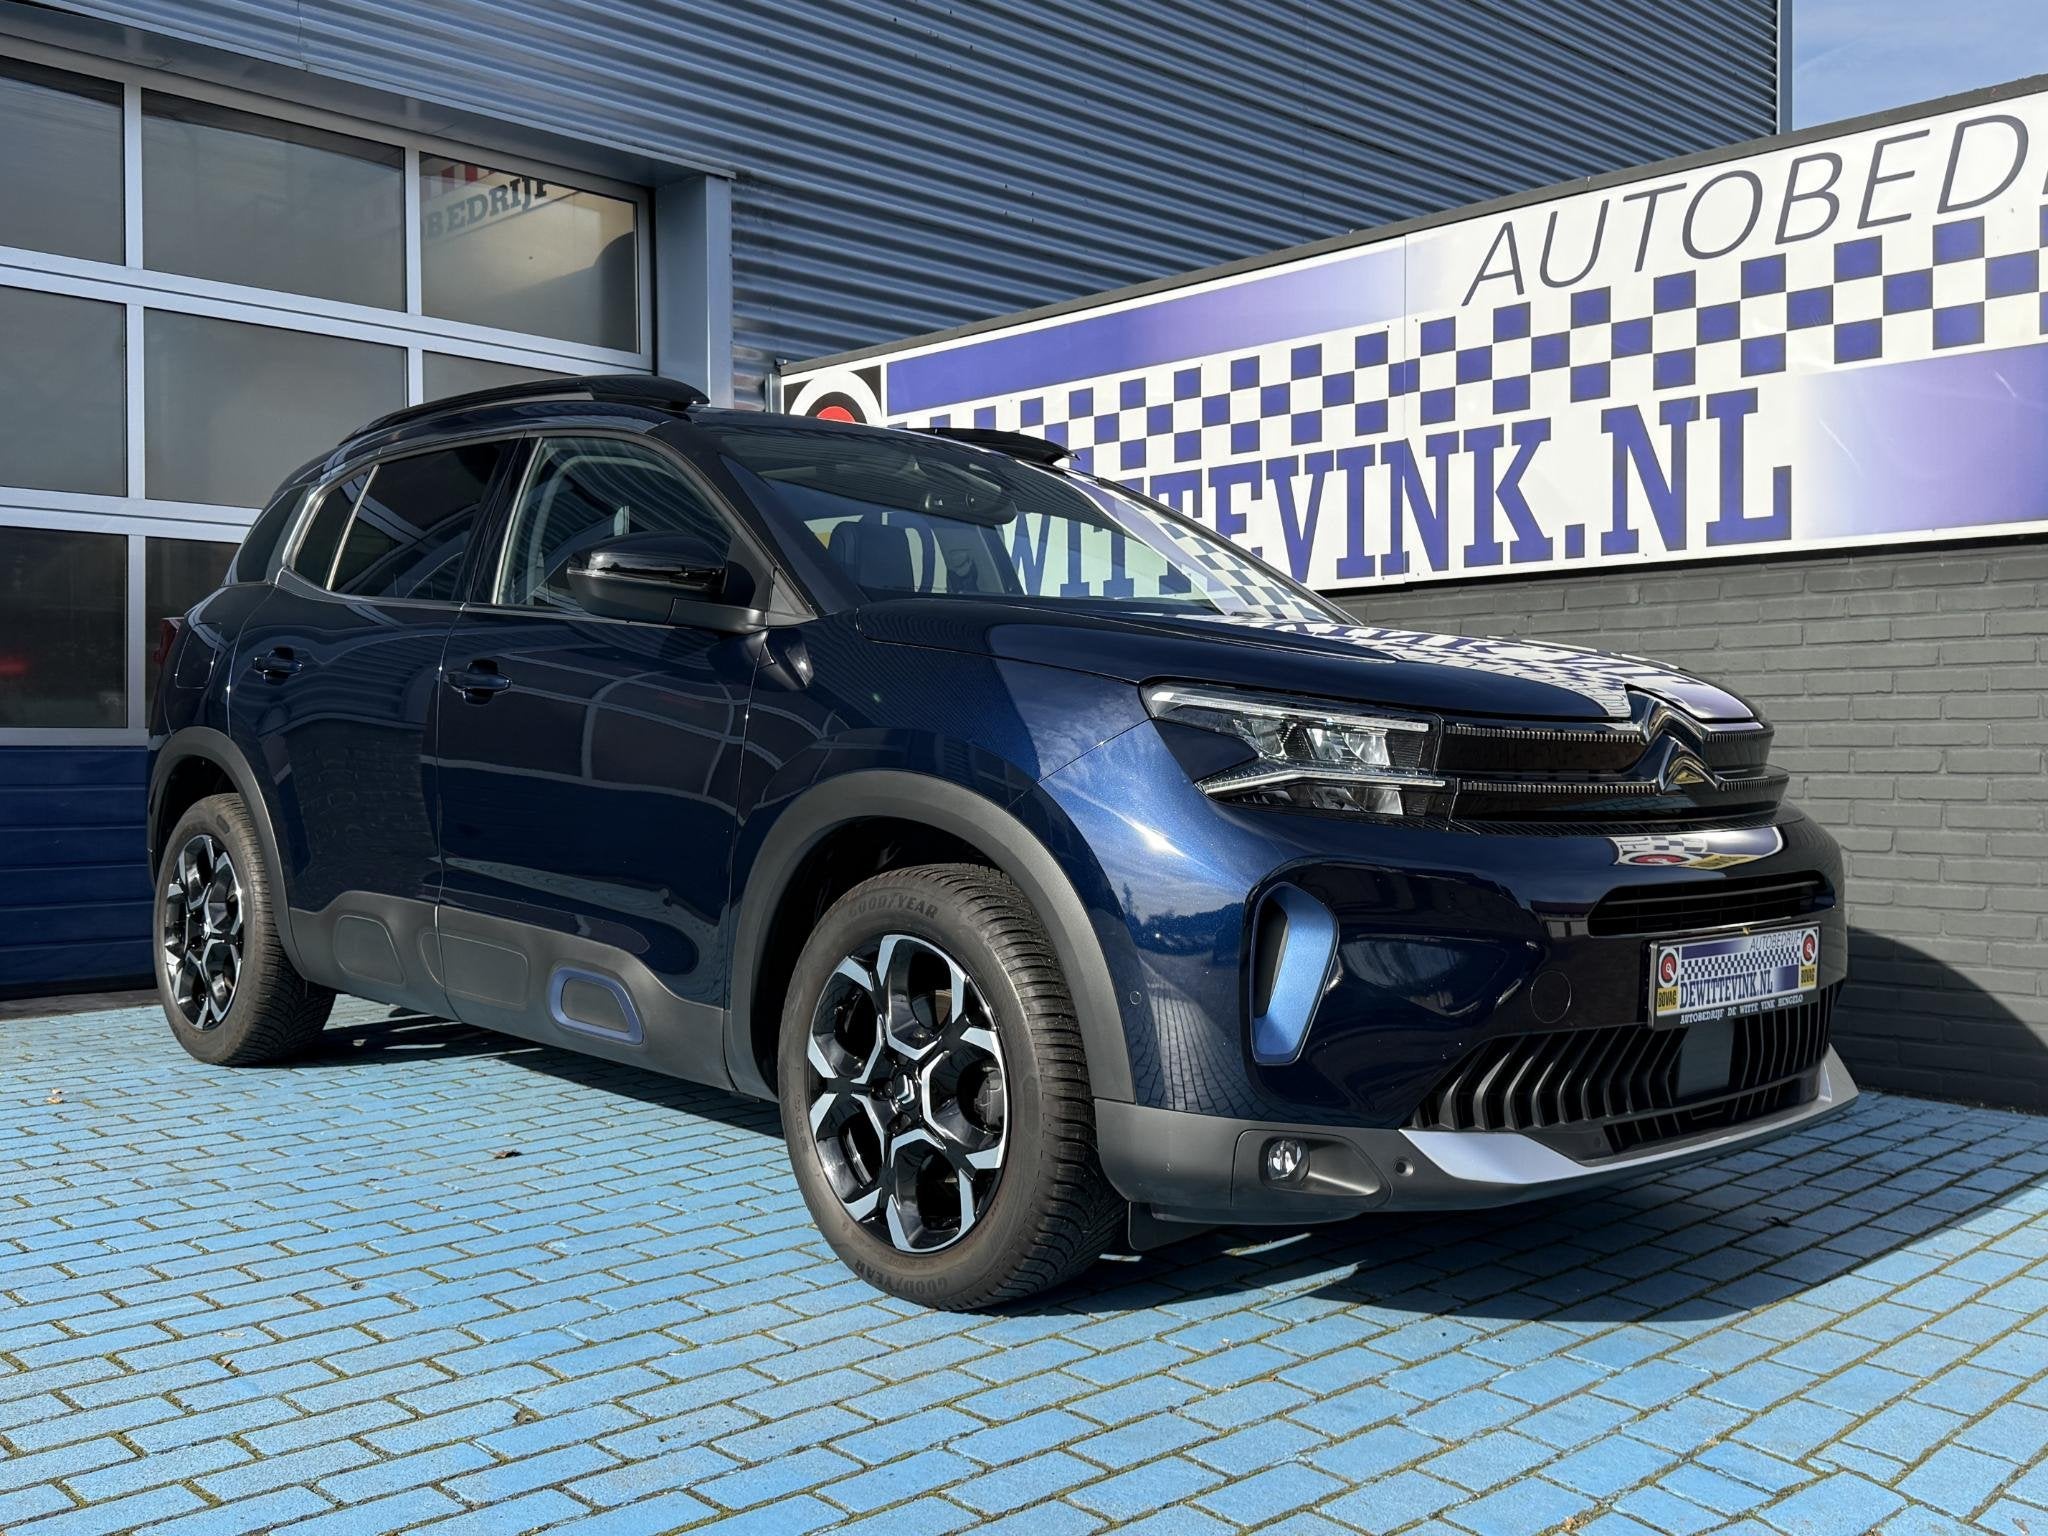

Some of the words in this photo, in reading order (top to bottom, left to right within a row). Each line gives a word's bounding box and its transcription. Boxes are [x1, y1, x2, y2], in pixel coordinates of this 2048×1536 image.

[1461, 113, 2048, 306] AUTOBED
[848, 894, 939, 920] GOODYEAR
[1750, 931, 1801, 951] AUTOBEDRIJF
[1658, 991, 1677, 1007] BOVAG
[1680, 970, 1773, 1008] DEWITTEVINK.NL
[1680, 1010, 1724, 1025] AUTOBEDRIJF
[1727, 1007, 1737, 1016] DE
[1739, 1003, 1758, 1015] WITTE
[1761, 1000, 1775, 1011] VINK
